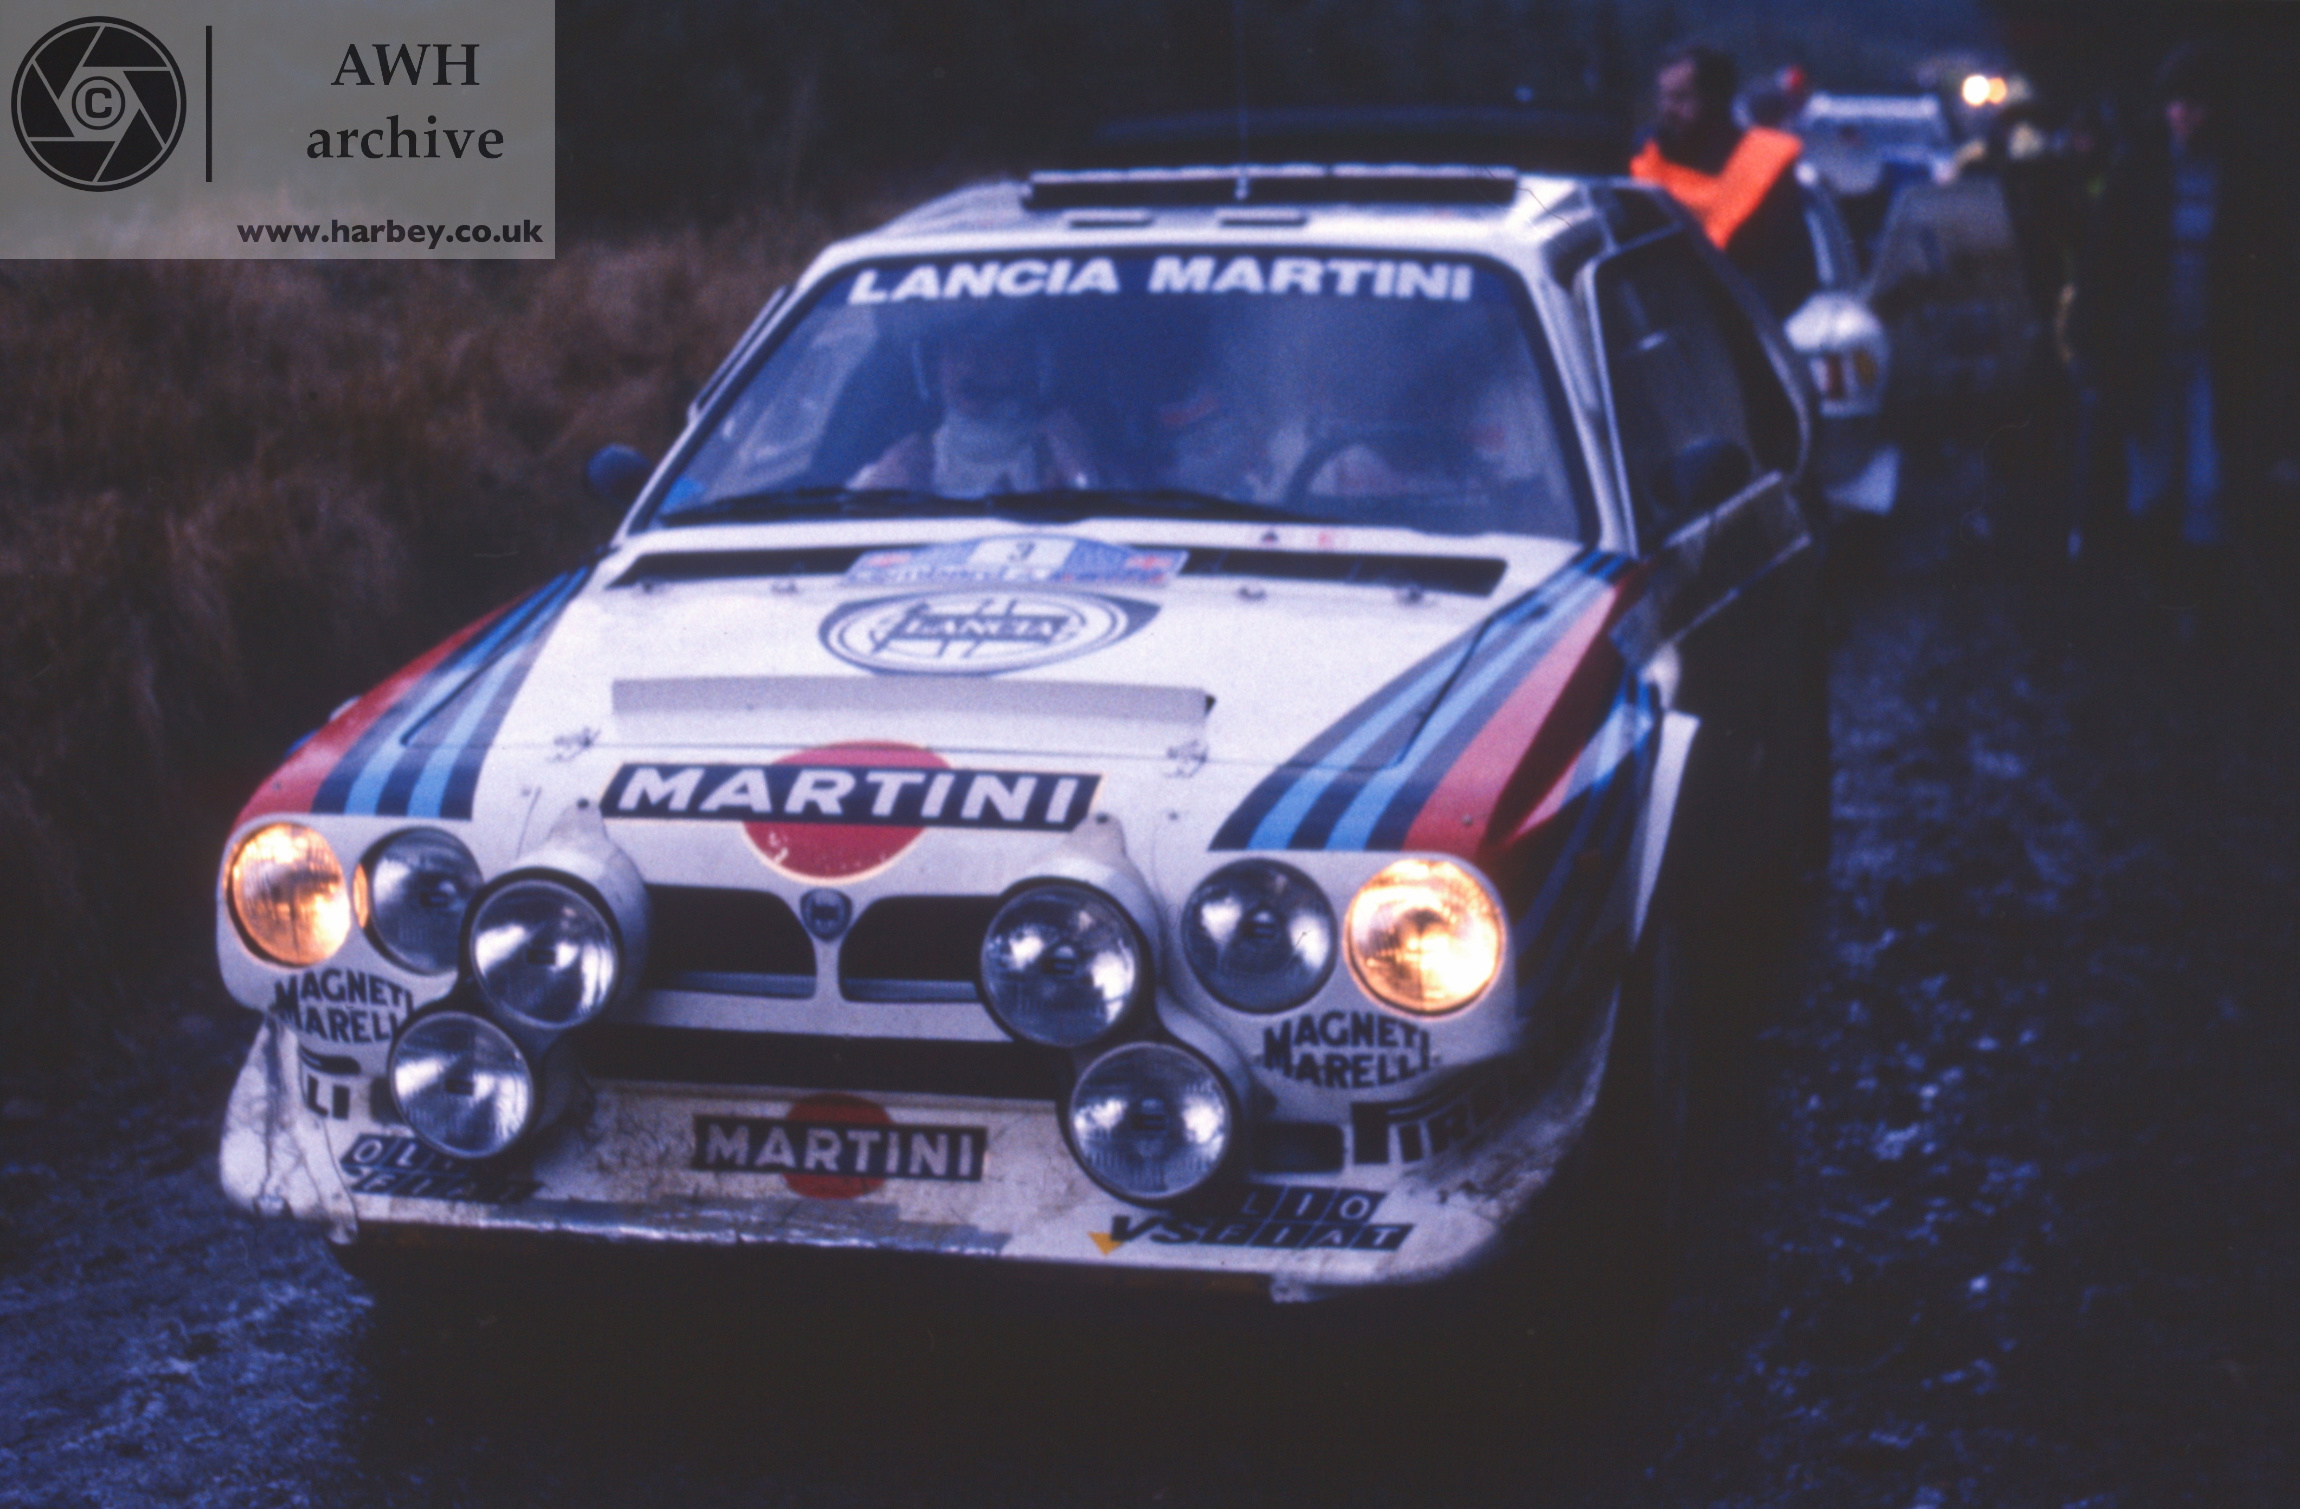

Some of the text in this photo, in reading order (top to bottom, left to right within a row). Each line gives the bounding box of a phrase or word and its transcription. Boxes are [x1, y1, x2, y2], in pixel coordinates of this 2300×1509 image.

[848, 255, 1473, 304] LANCIA MARTINI
[906, 616, 1055, 638] LANCIA
[617, 766, 1079, 824] MARTINI
[274, 967, 415, 1021] MAGNETI
[1262, 1010, 1431, 1066] MAGNETI
[1263, 1036, 1430, 1088] MARELLI
[705, 1123, 974, 1178] MARTINI
[1239, 1189, 1374, 1221] LIO
[1216, 1223, 1401, 1247] FIAT
